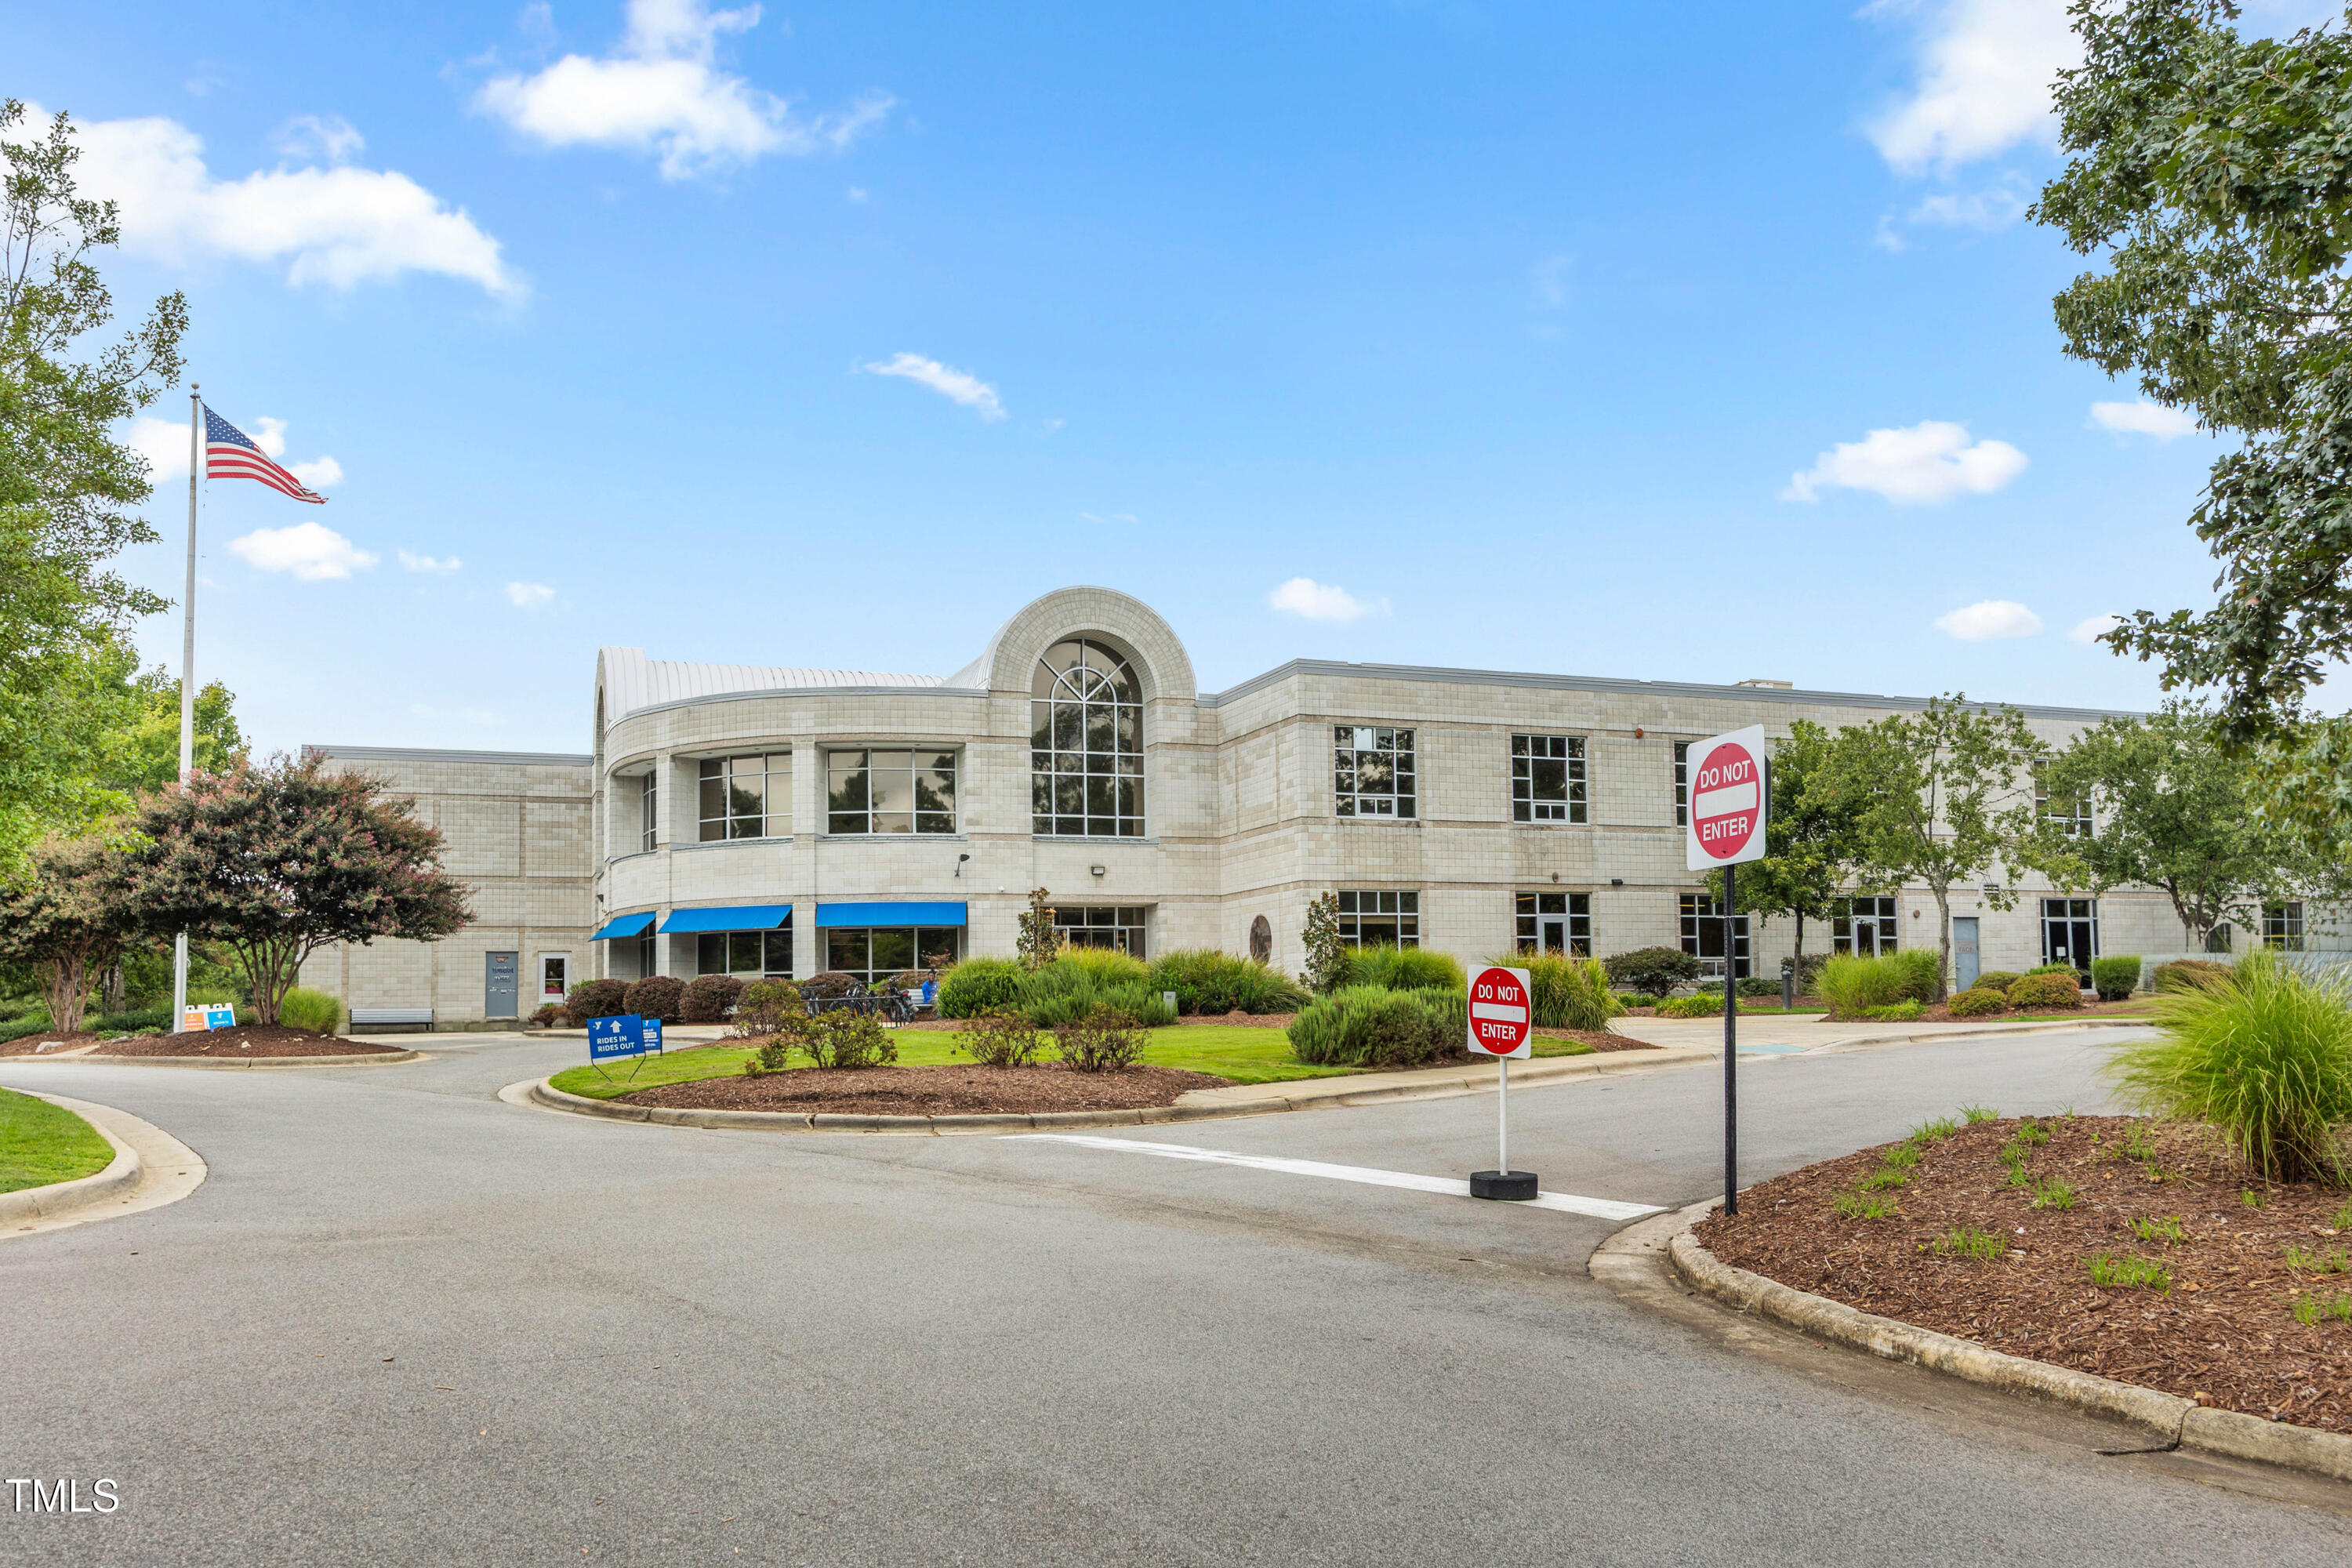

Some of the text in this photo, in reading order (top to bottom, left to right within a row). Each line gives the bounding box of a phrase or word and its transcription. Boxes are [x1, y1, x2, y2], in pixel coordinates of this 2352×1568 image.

[1700, 759, 1751, 789] DO NOT
[1703, 816, 1748, 842] ENTER
[1478, 984, 1519, 1002] DO NOT
[1482, 1022, 1516, 1041] ENTER
